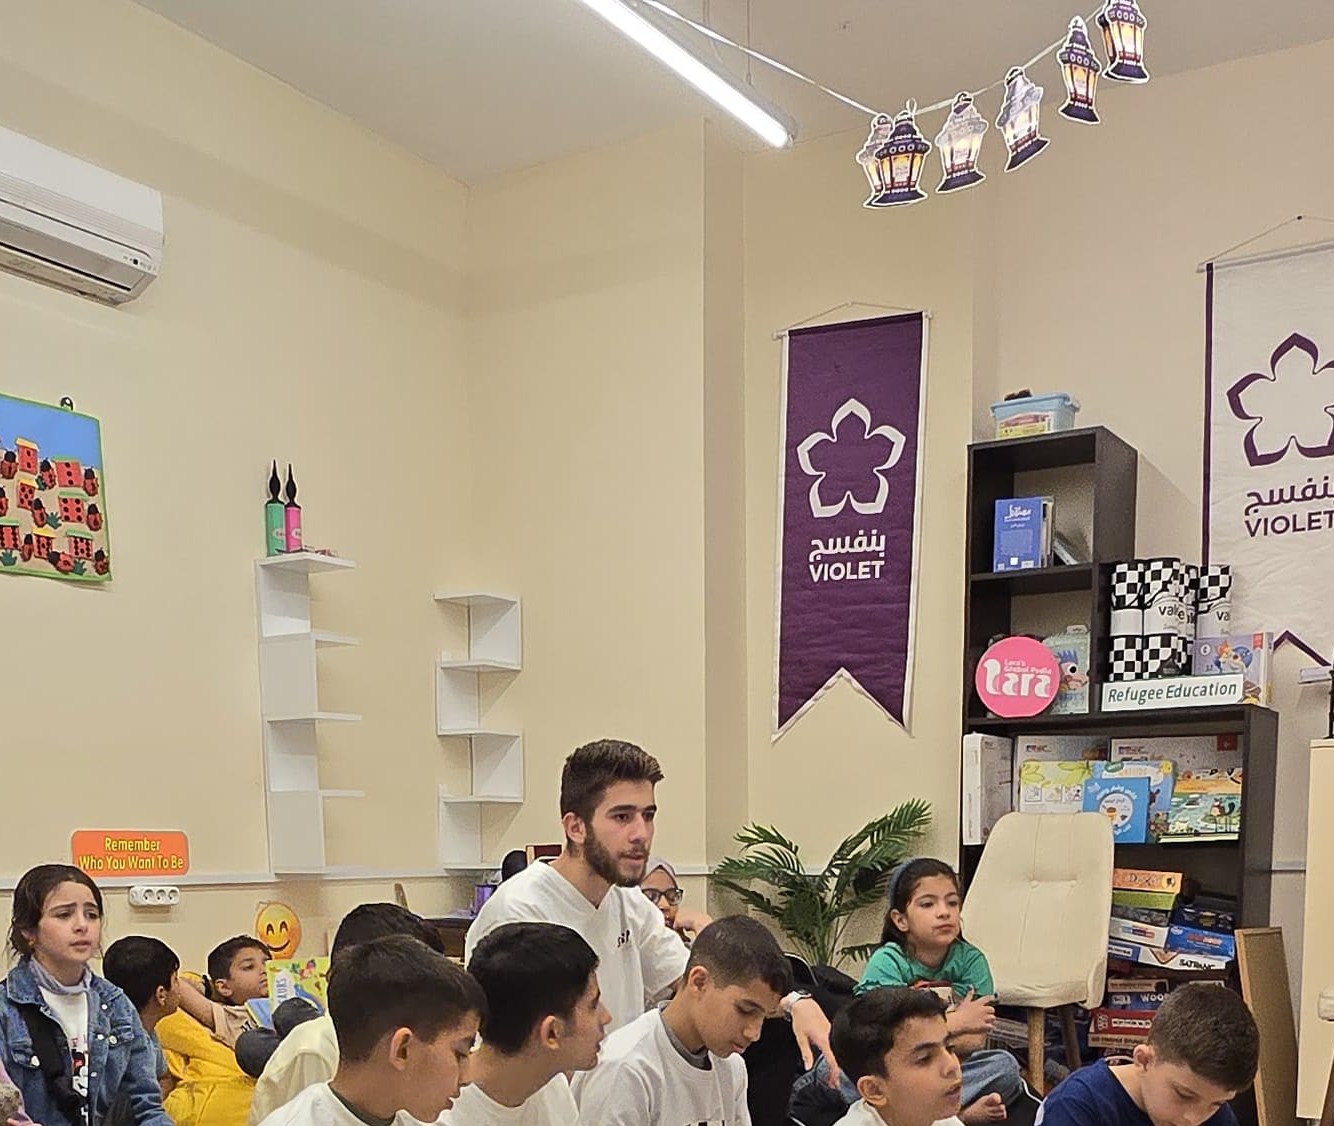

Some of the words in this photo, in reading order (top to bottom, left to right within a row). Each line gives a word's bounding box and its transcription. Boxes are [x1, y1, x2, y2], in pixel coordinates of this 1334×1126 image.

[809, 529, 886, 562] بنفسج
[809, 560, 885, 583] VIOLET
[1108, 688, 1164, 706] Refugee
[1166, 681, 1237, 700] Education
[105, 837, 161, 852] Remember
[79, 855, 104, 870] Who
[106, 855, 126, 870] You
[128, 855, 155, 870] Want
[157, 855, 169, 869] To
[170, 855, 184, 870] Be
